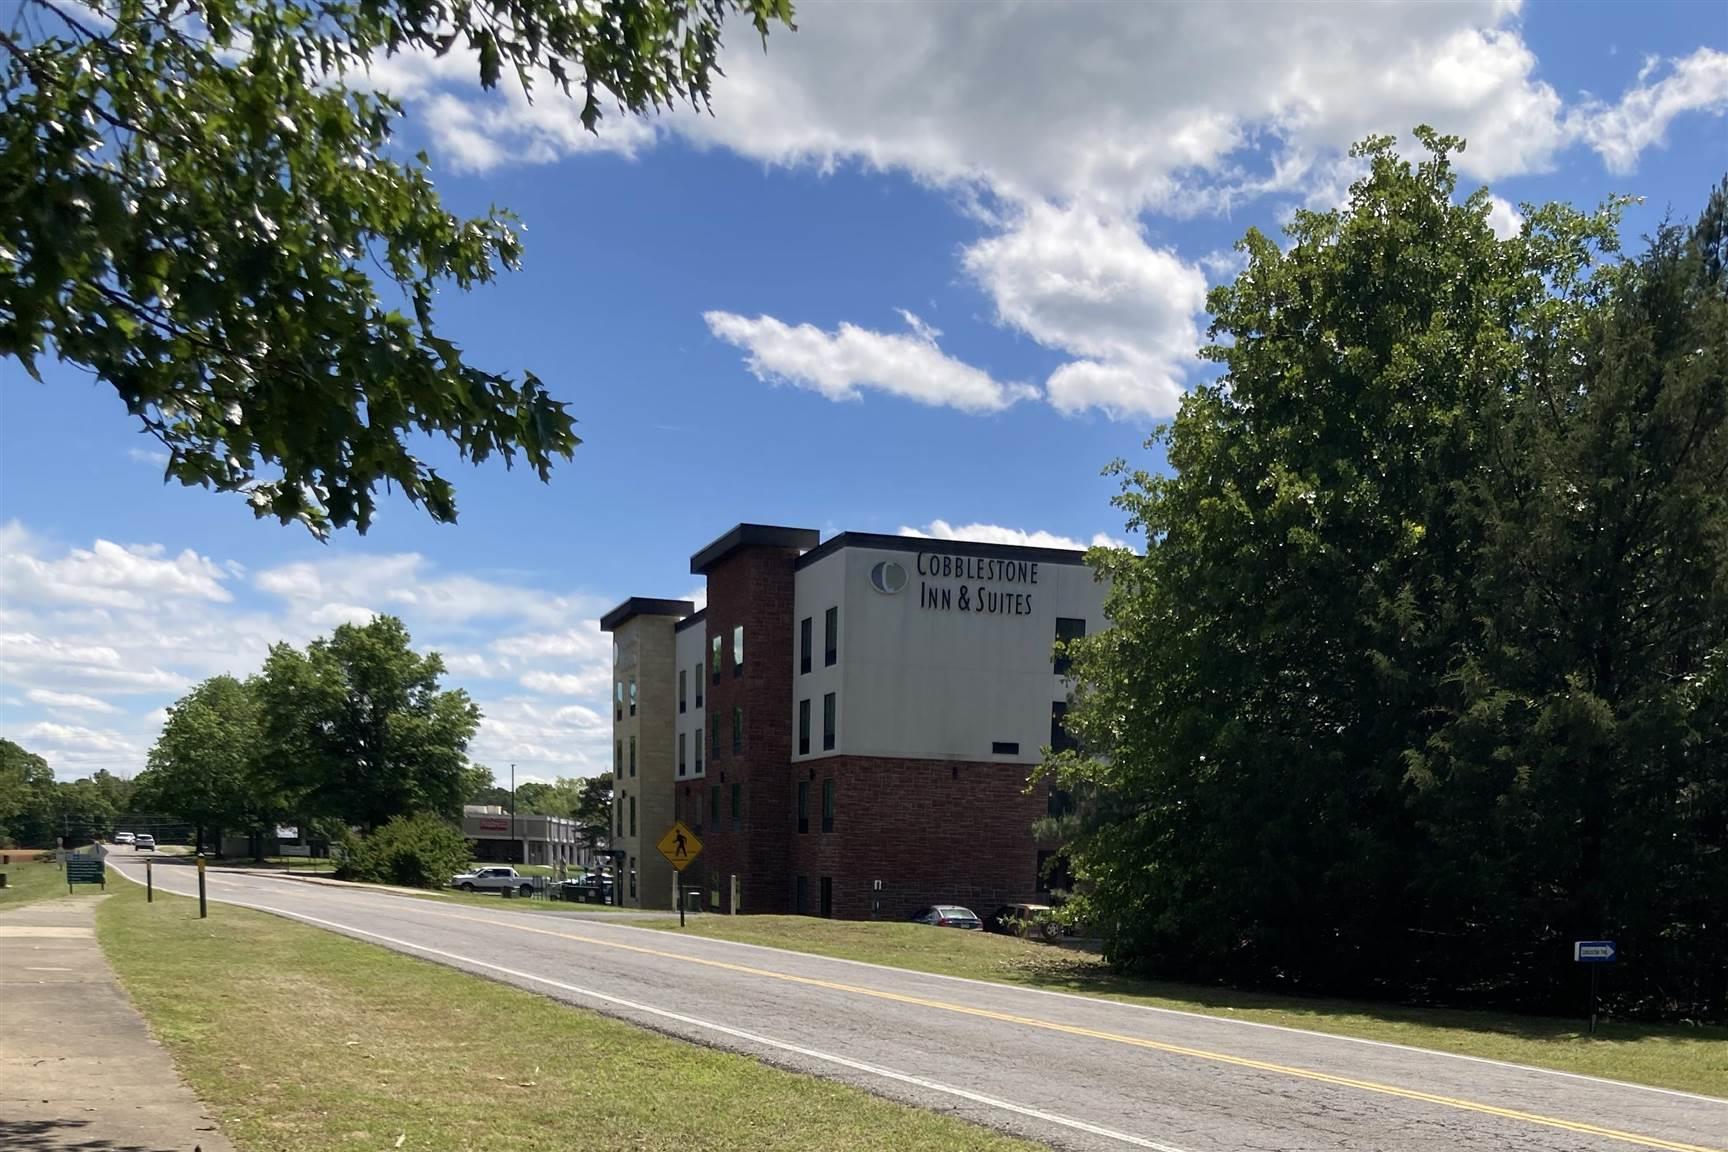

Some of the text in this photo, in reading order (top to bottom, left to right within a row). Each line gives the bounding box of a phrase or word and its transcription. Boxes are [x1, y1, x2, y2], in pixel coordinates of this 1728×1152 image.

[917, 551, 1038, 584] COBBLESTONE
[921, 582, 1032, 615] INN & SUITES
